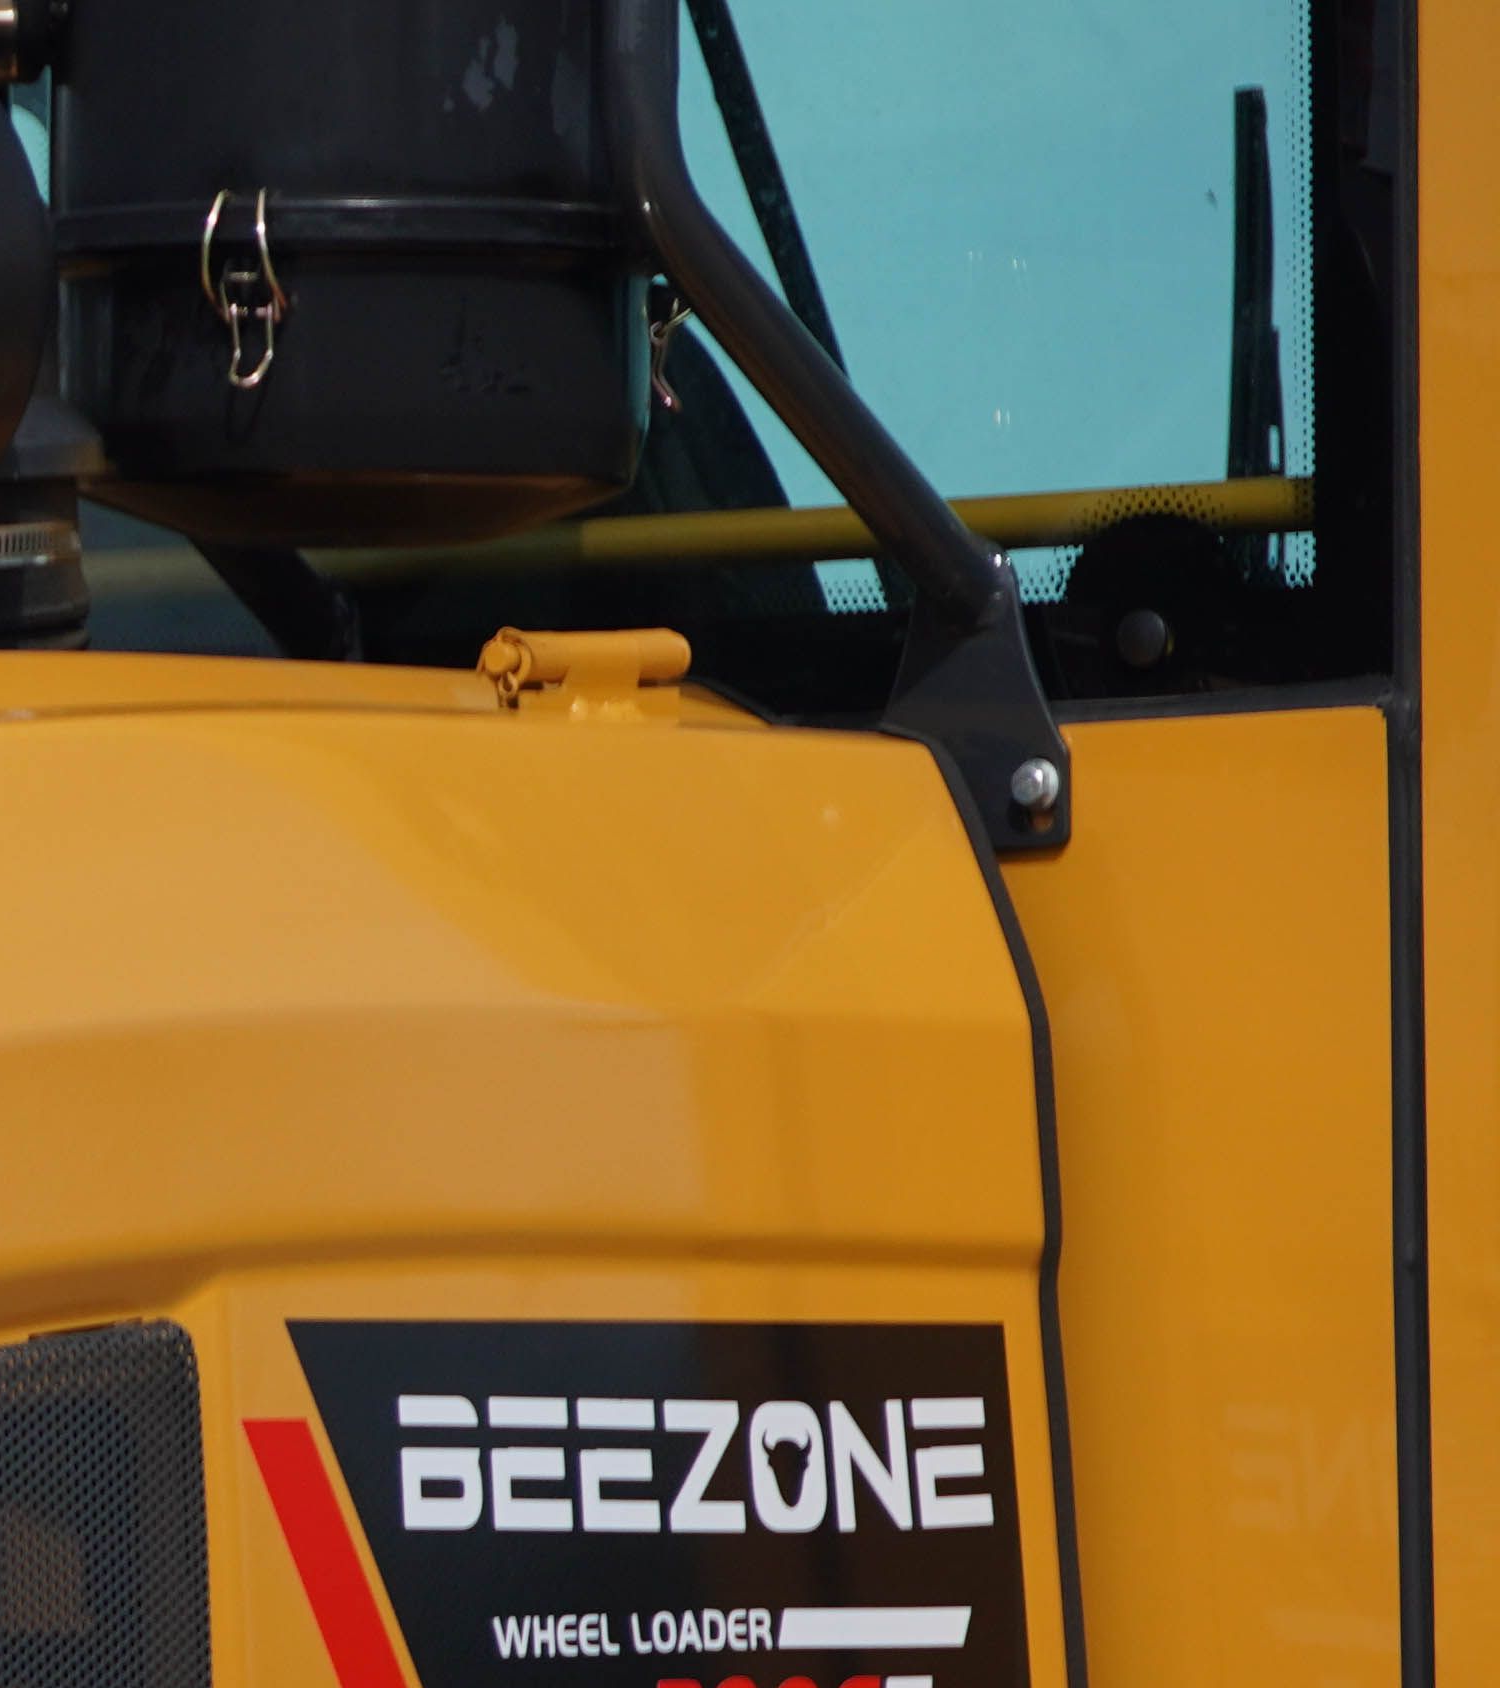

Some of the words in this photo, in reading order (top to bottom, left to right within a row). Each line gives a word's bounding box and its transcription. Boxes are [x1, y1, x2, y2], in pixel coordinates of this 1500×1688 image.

[397, 1393, 995, 1534] BEEZONE
[492, 1613, 620, 1659] WHEEL
[630, 1607, 774, 1655] LOADER
